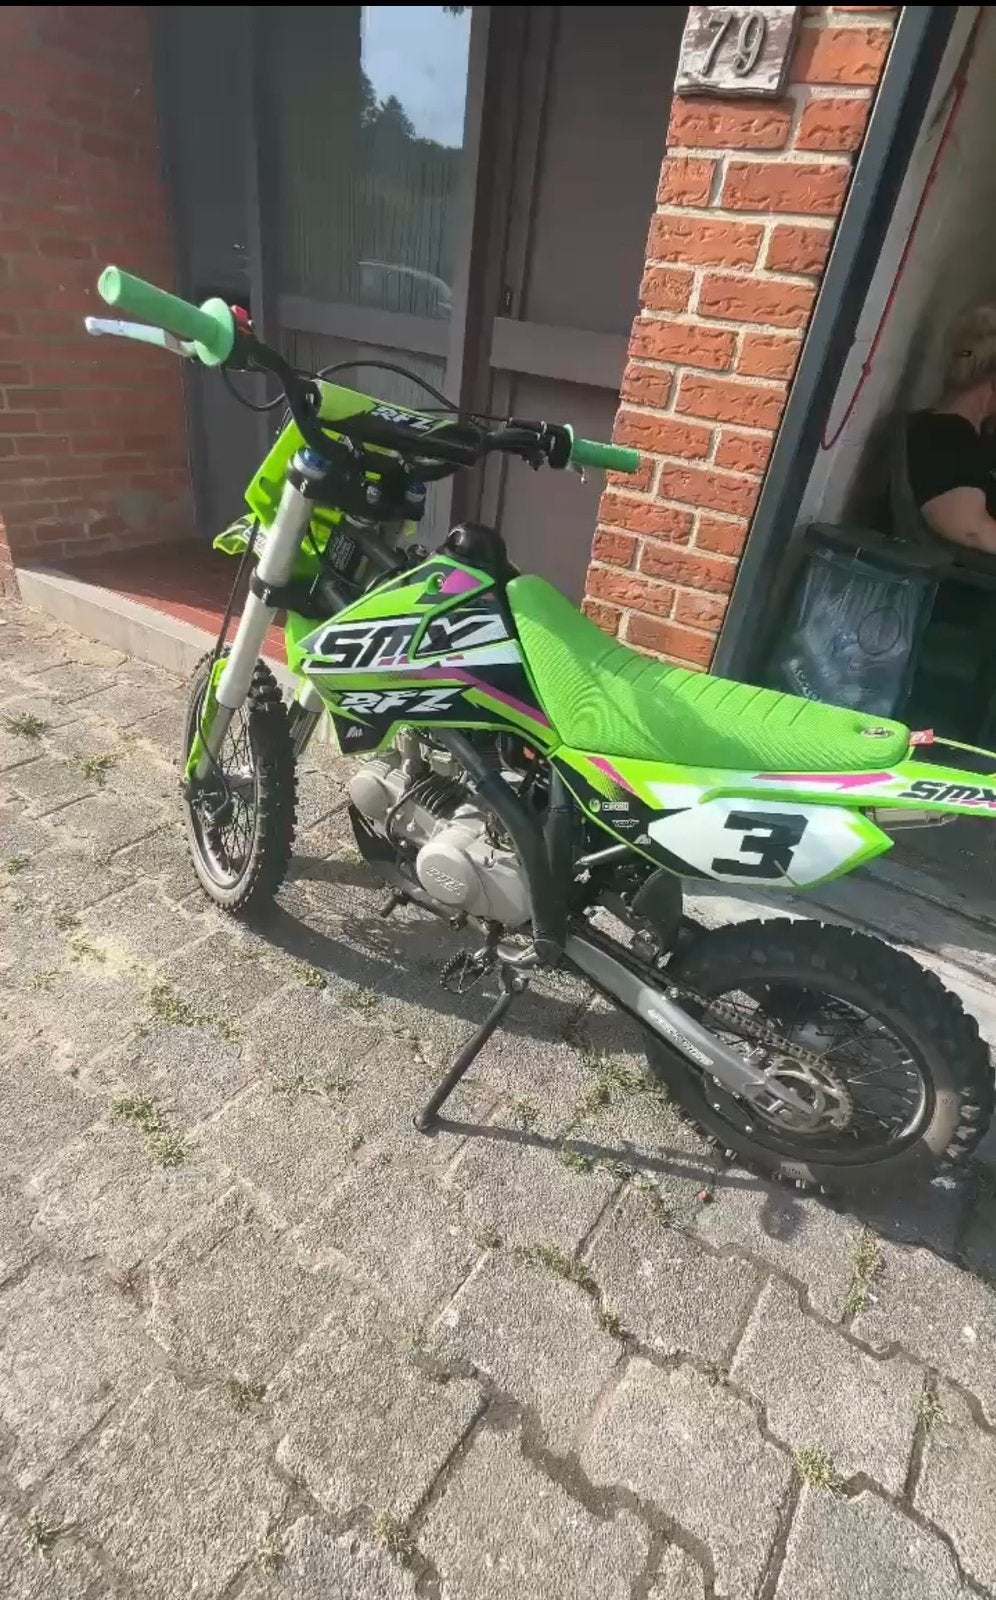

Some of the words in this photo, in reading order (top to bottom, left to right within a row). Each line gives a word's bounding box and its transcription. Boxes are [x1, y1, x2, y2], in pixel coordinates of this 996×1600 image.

[702, 10, 765, 76] 79
[372, 404, 433, 430] RFZ
[308, 617, 495, 668] SMX
[338, 687, 463, 714] RFZ
[711, 810, 809, 879] 3
